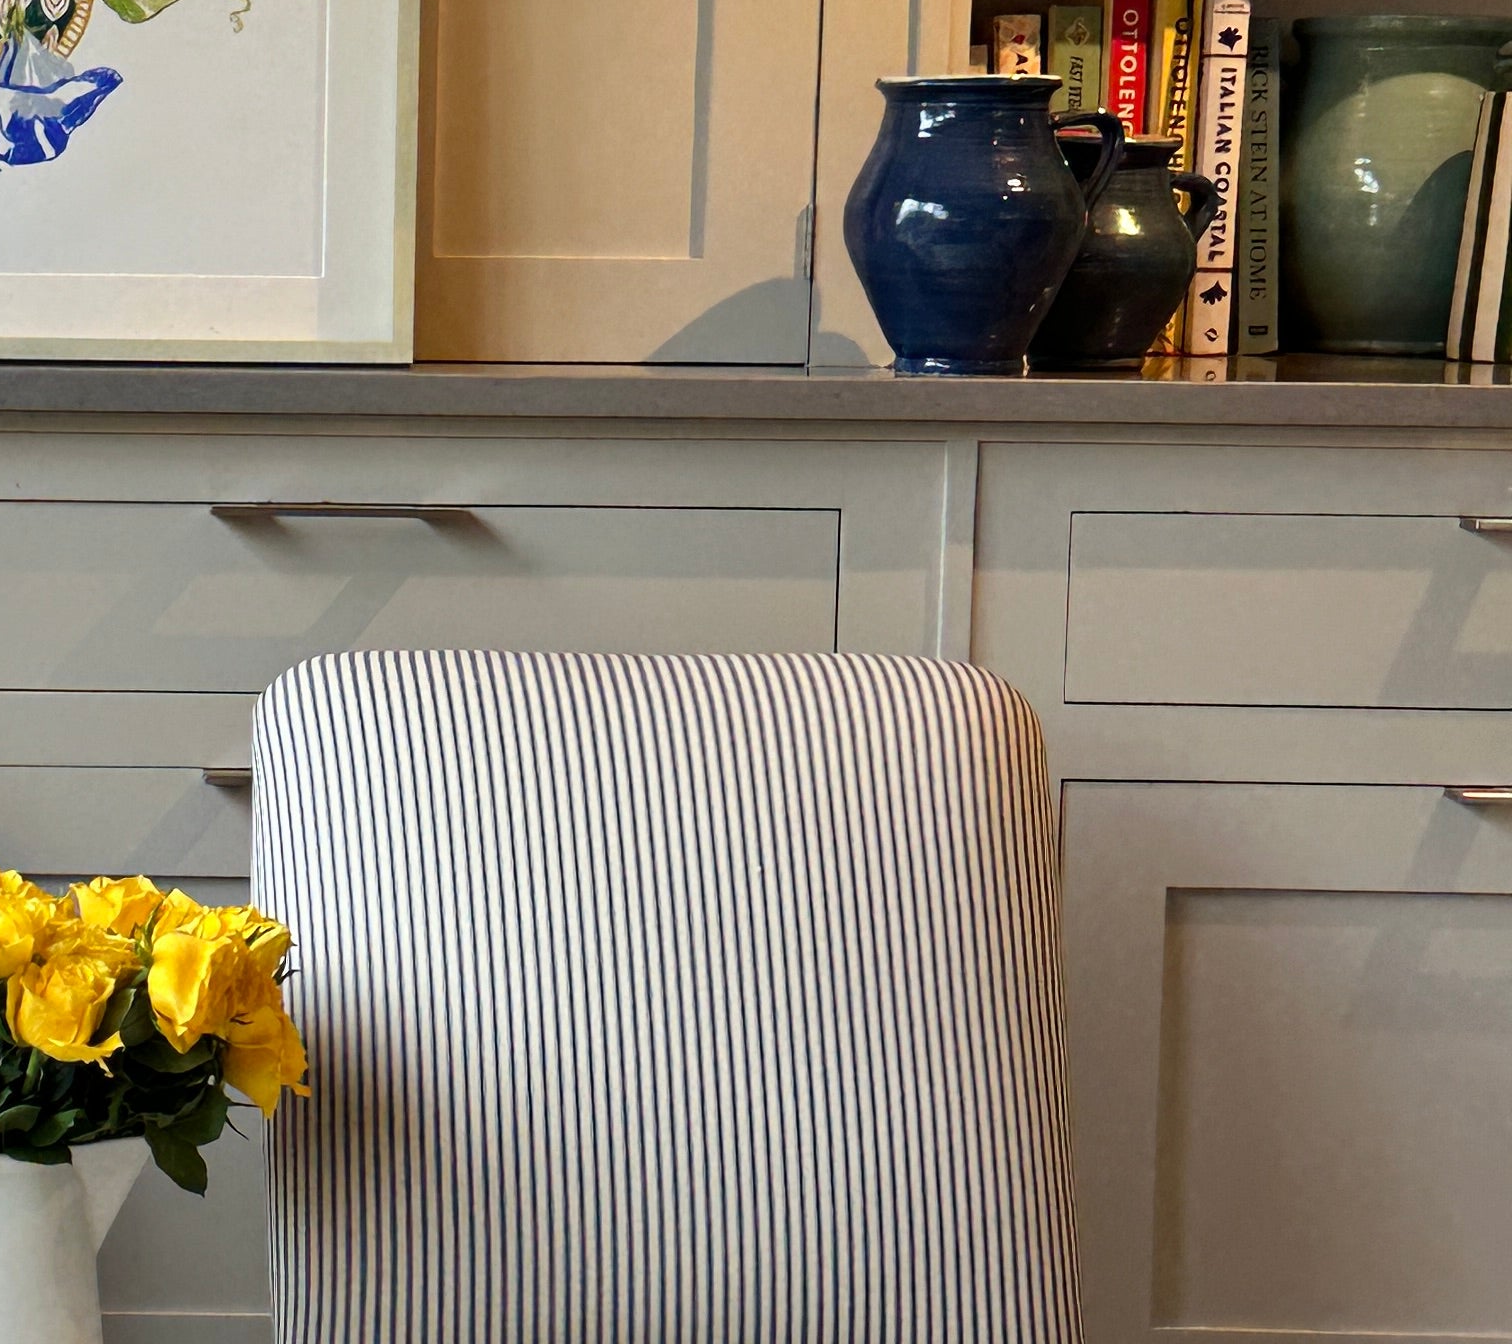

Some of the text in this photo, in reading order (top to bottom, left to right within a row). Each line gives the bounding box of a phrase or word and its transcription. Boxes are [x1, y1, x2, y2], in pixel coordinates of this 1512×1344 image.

[1208, 67, 1237, 262] ITALIAN COASTAL
[1249, 46, 1267, 300] RICK STEIN AT HOME
